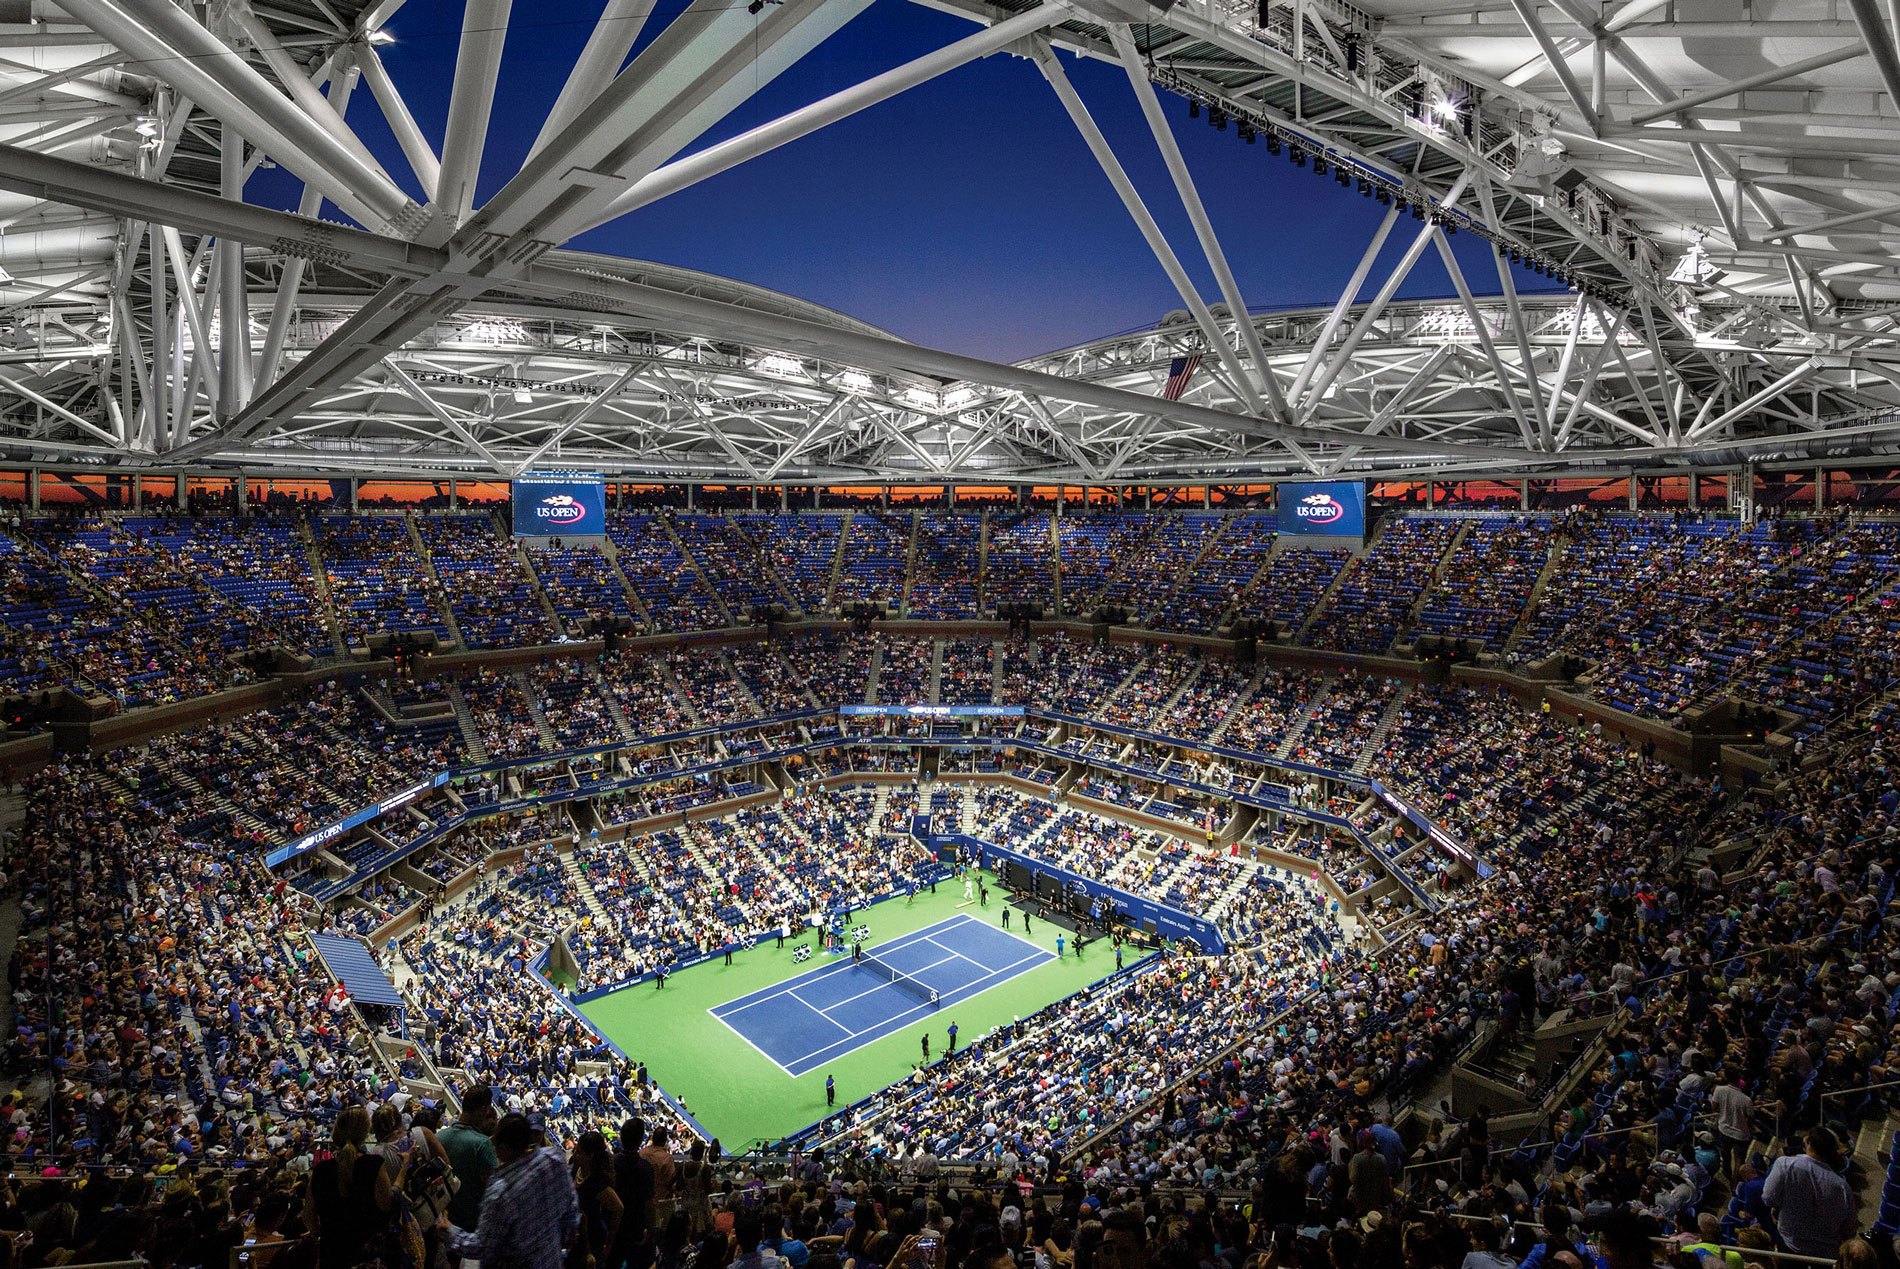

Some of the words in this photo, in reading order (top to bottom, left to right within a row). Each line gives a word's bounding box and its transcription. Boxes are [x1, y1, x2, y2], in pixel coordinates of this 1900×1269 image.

[536, 507, 550, 517] US
[550, 507, 578, 517] OPEN
[1296, 506, 1310, 516] US
[1310, 506, 1336, 516] OPEN
[1196, 744, 1213, 752] CHASE
[600, 783, 618, 792] CHASE
[1210, 788, 1229, 798] CITIZEN
[314, 832, 324, 842] US
[324, 822, 343, 838] OPEN
[682, 954, 710, 968] Mercedes-Benz
[615, 981, 630, 990] Mount
[630, 976, 642, 986] Sinai
